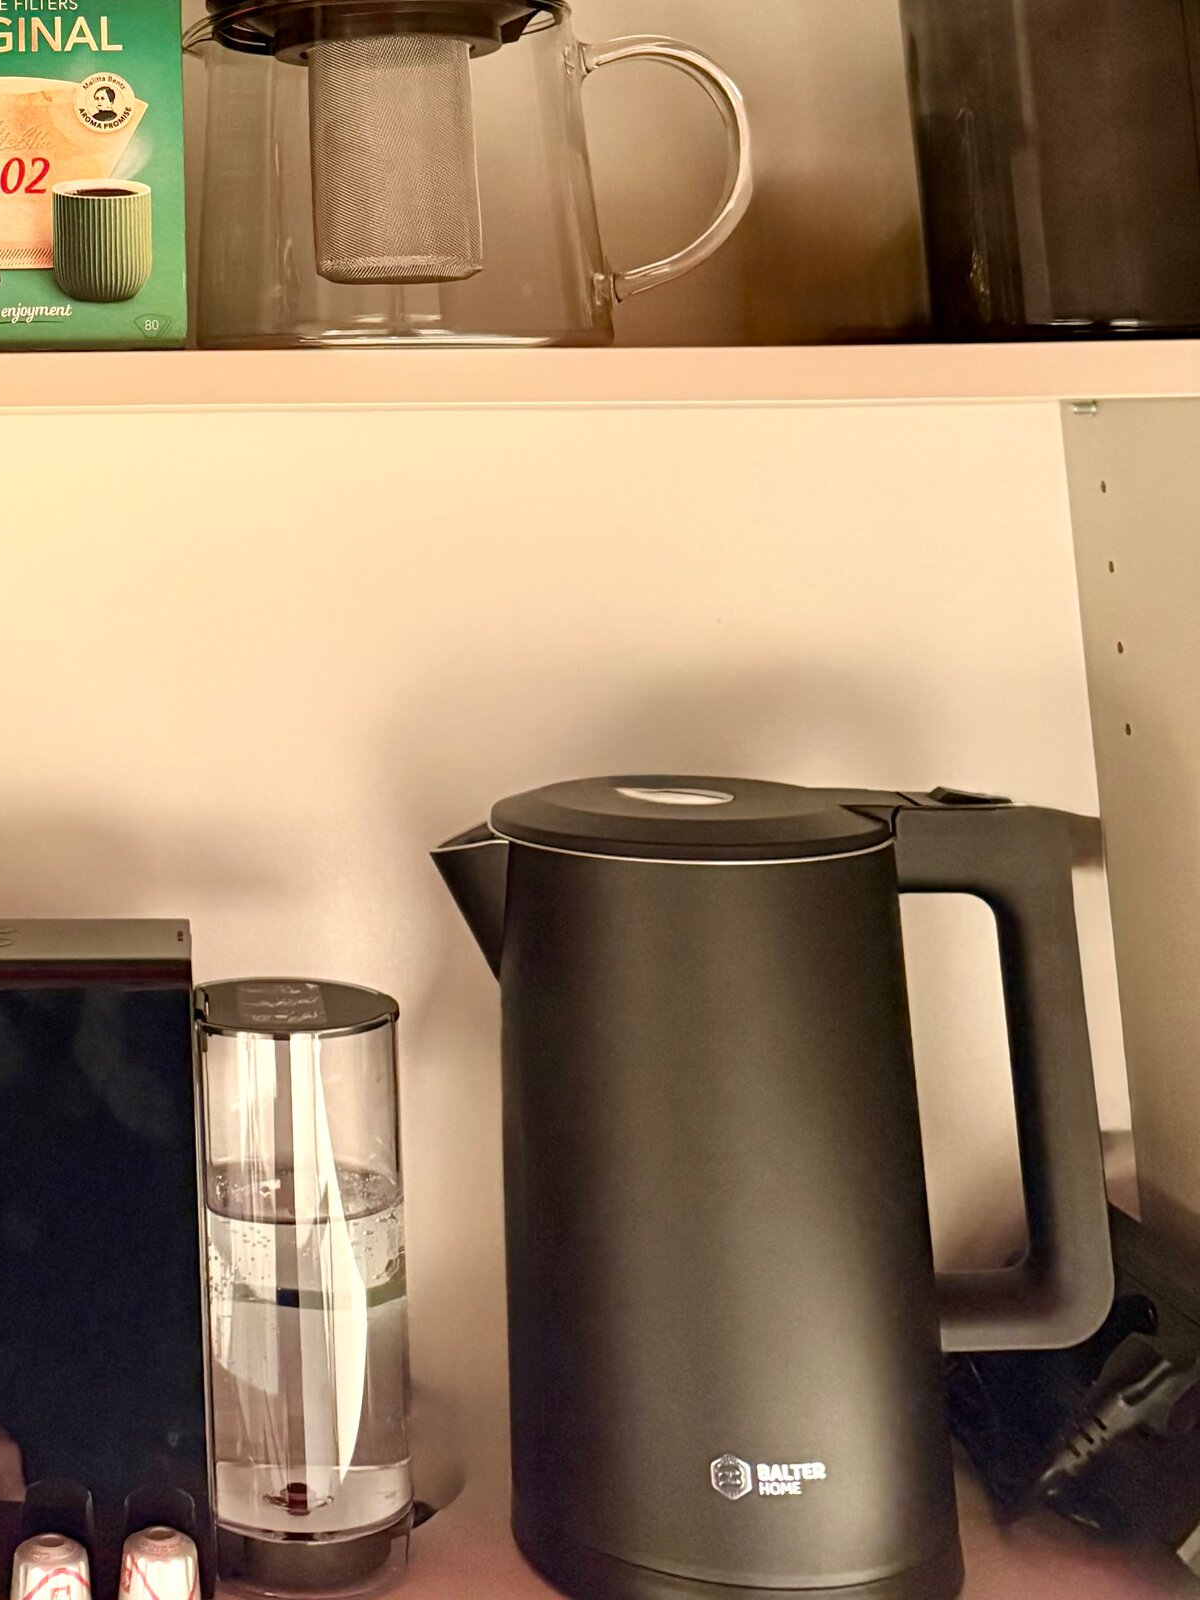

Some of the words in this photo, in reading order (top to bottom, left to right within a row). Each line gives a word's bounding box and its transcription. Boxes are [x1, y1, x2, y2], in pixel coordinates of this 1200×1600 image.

[78, 108, 102, 129] AROMA
[103, 106, 132, 129] PROMISE
[0, 302, 73, 324] enjoyment
[144, 319, 160, 331] 80
[756, 1462, 827, 1482] BALTER
[758, 1481, 802, 1496] HOME
